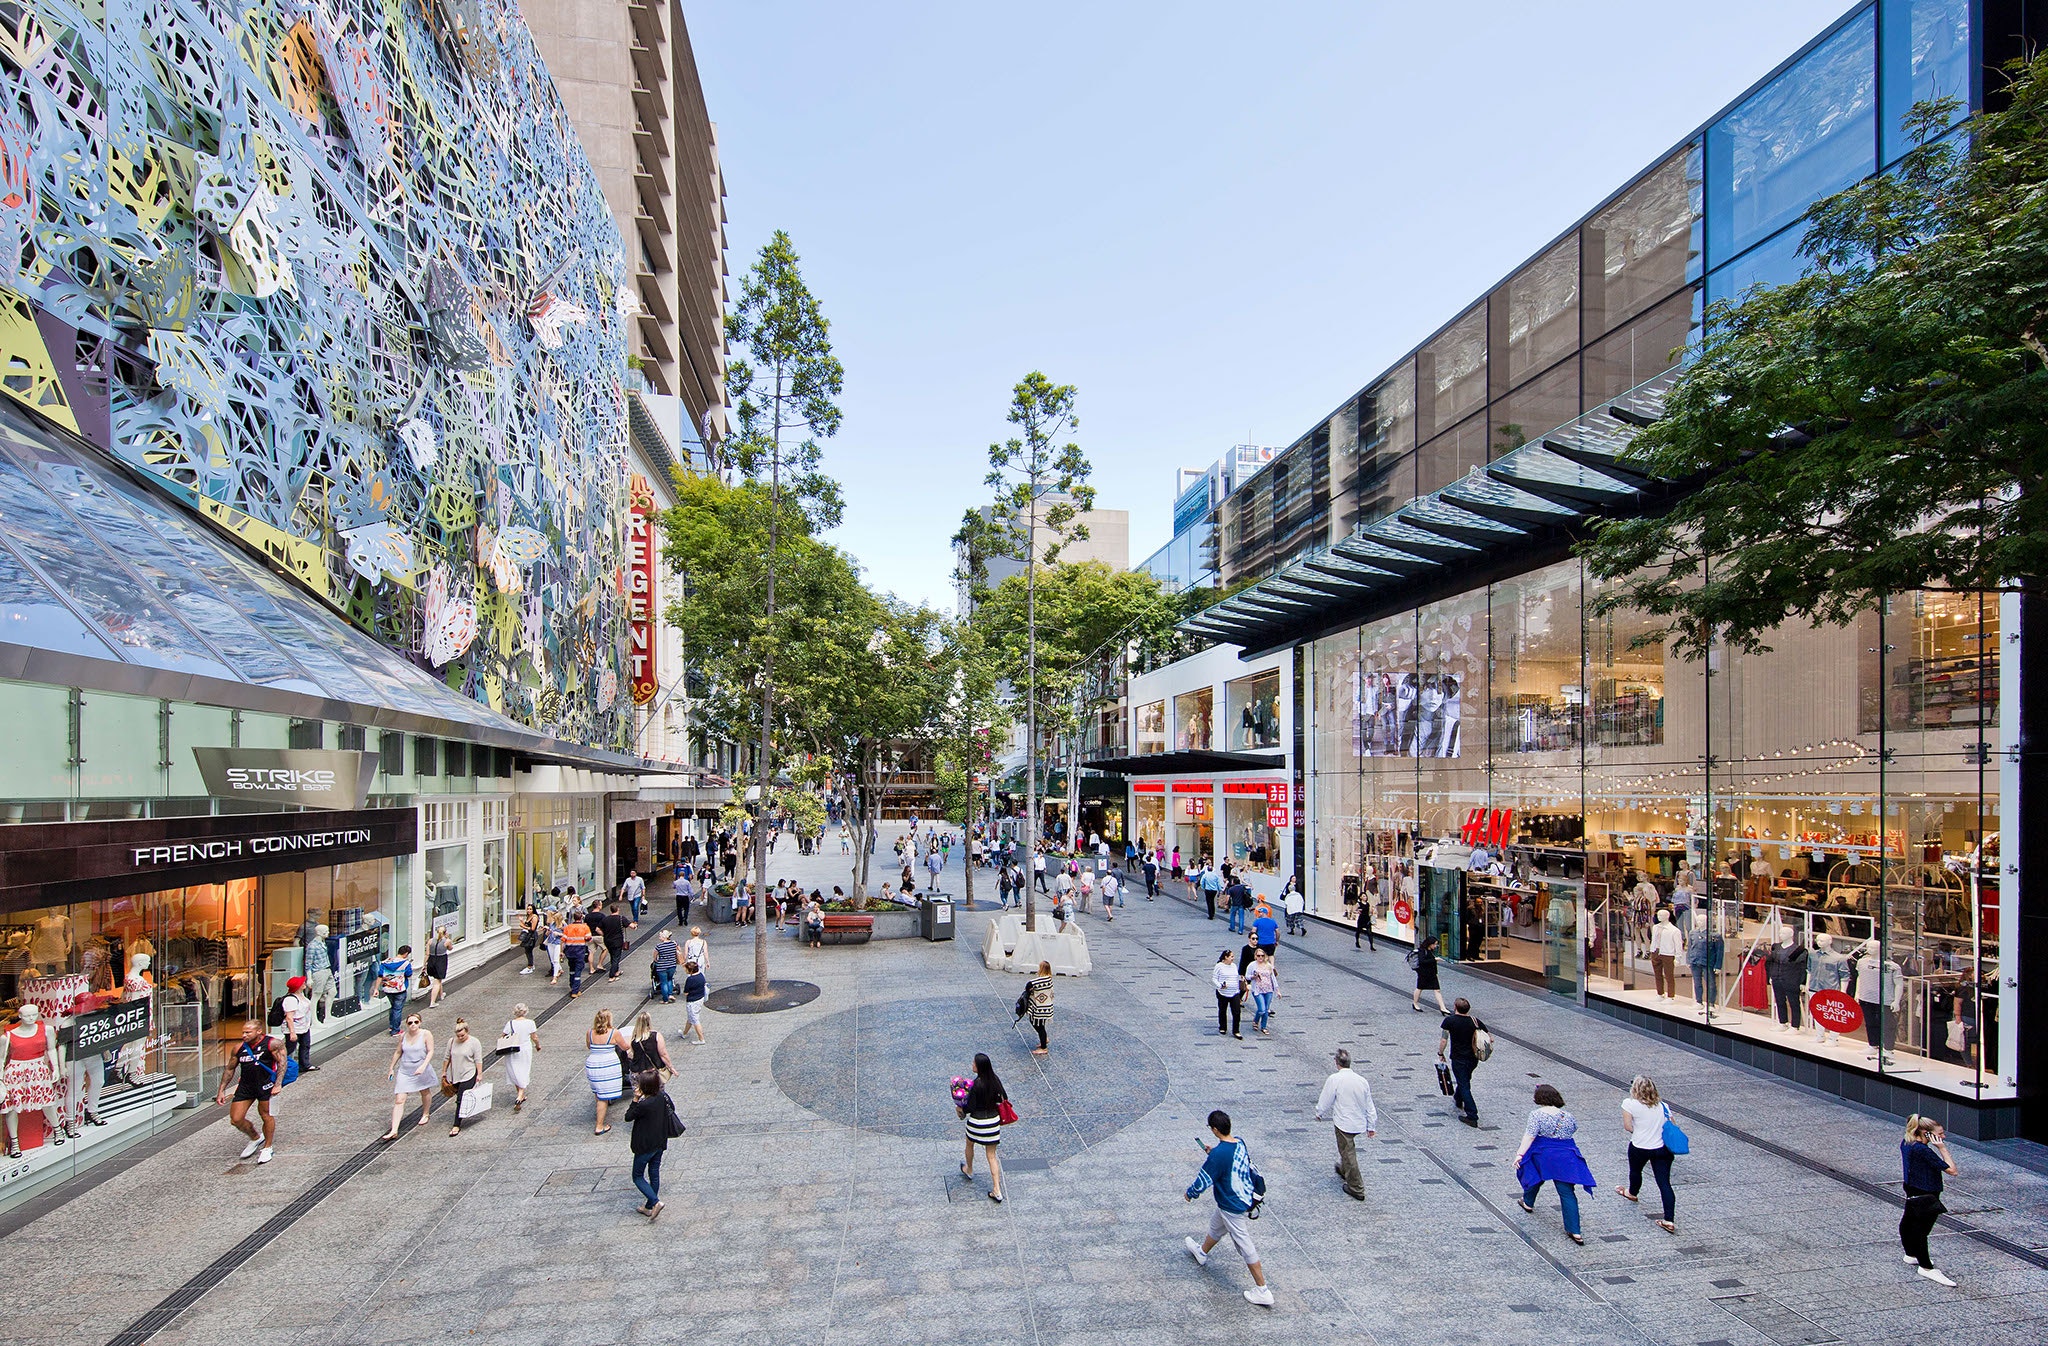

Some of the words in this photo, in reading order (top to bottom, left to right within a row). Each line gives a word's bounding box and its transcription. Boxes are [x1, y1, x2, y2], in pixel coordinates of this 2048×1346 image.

[630, 513, 648, 678] REGENT
[226, 768, 336, 784] STRIKE
[232, 782, 297, 791] BOWLING
[1270, 817, 1286, 826] QLO
[1461, 808, 1512, 850] H&M
[131, 840, 242, 866] FRENCH
[250, 829, 371, 854] CONNECTION
[347, 939, 362, 951] 25%
[362, 933, 378, 946] OFF
[347, 941, 378, 957] STOREWIDE
[1816, 1003, 1855, 1019] SEASON
[1826, 999, 1845, 1009] MID
[79, 1017, 111, 1039] 25%
[114, 1007, 145, 1026] OFF
[1823, 1012, 1847, 1024] SALE
[79, 1019, 145, 1048] STOREWIDE
